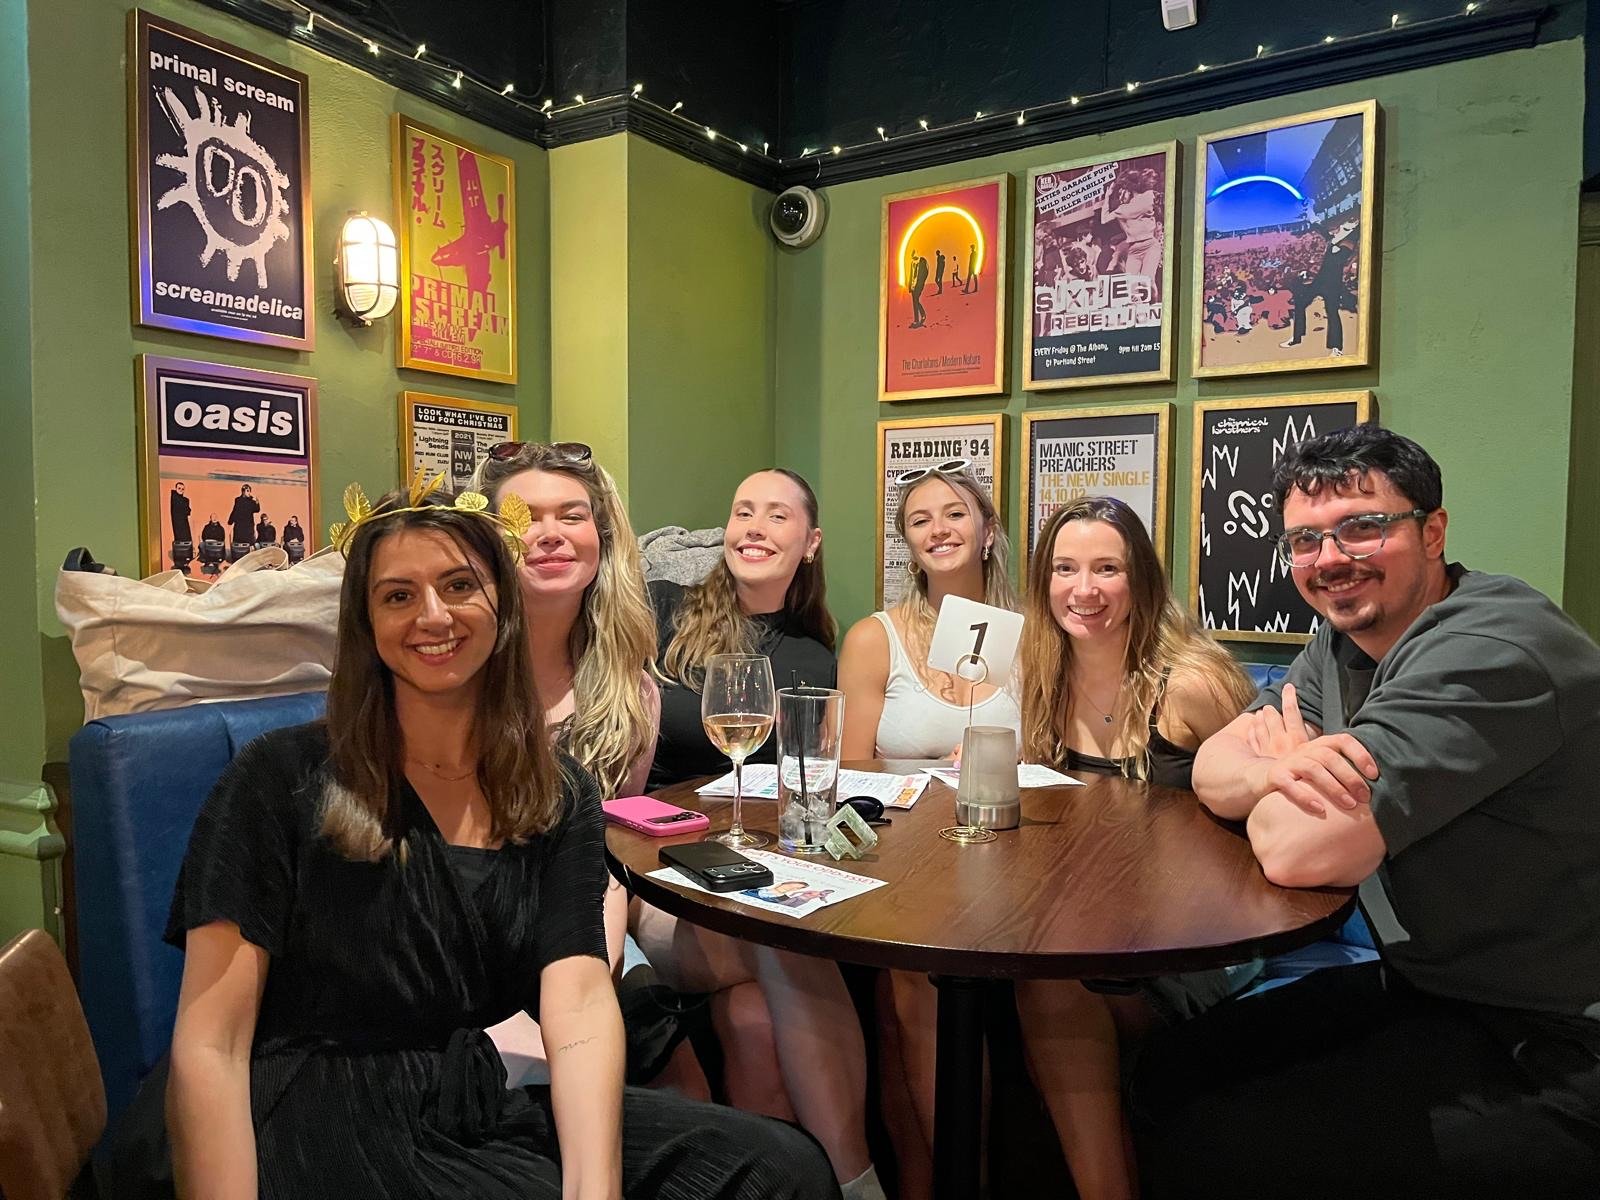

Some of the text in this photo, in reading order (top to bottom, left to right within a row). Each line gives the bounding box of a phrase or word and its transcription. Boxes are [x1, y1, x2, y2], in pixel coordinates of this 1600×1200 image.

[150, 51, 294, 112] primal scream
[1062, 175, 1092, 192] GARAGE
[1040, 200, 1060, 212] WILD
[1061, 176, 1106, 202] ROCKABILLY
[1055, 187, 1102, 214] KILLER SURF
[155, 280, 304, 321] screamadelica
[1036, 279, 1149, 312] SIXTIES
[1051, 307, 1161, 330] REBELLION
[1034, 348, 1051, 356] EVERY
[1052, 346, 1069, 355] Friday
[1077, 344, 1087, 352] The
[903, 360, 911, 371] The
[1054, 357, 1077, 366] Portland
[1078, 355, 1097, 364] Street
[174, 400, 293, 437] oasis
[418, 407, 503, 423] LOOK WHAT I'VE GOT
[418, 414, 436, 422] YOU
[457, 420, 503, 429] CHRISTMAS
[418, 436, 449, 445] Lightning
[1039, 439, 1138, 458] MANIC STREET
[454, 450, 473, 460] NW
[454, 462, 472, 472] RA
[1039, 456, 1116, 473] PREACHERS
[1040, 471, 1149, 488] THE NEW SINGLE
[970, 622, 988, 665] 1
